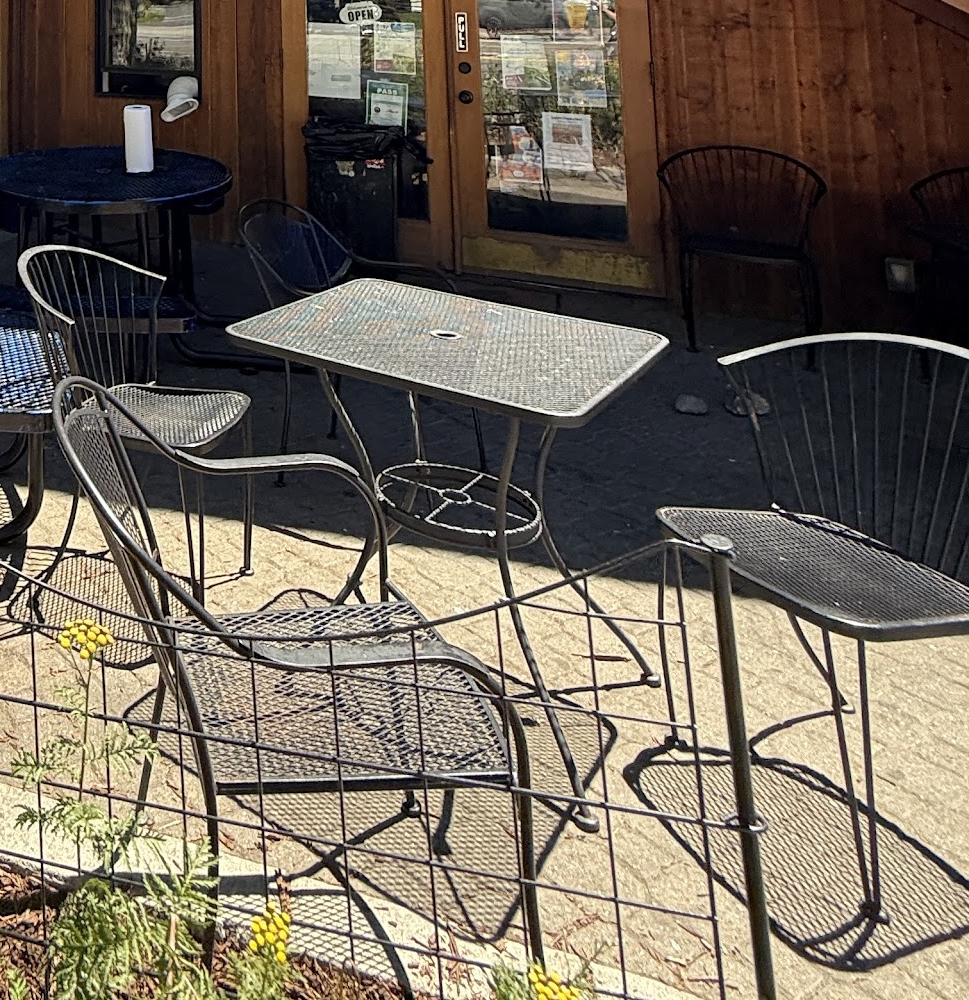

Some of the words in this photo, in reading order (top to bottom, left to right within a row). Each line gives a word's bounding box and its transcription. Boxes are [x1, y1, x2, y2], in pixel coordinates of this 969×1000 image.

[347, 8, 375, 23] OPEN
[457, 16, 466, 49] PULL
[376, 87, 398, 96] PASS
